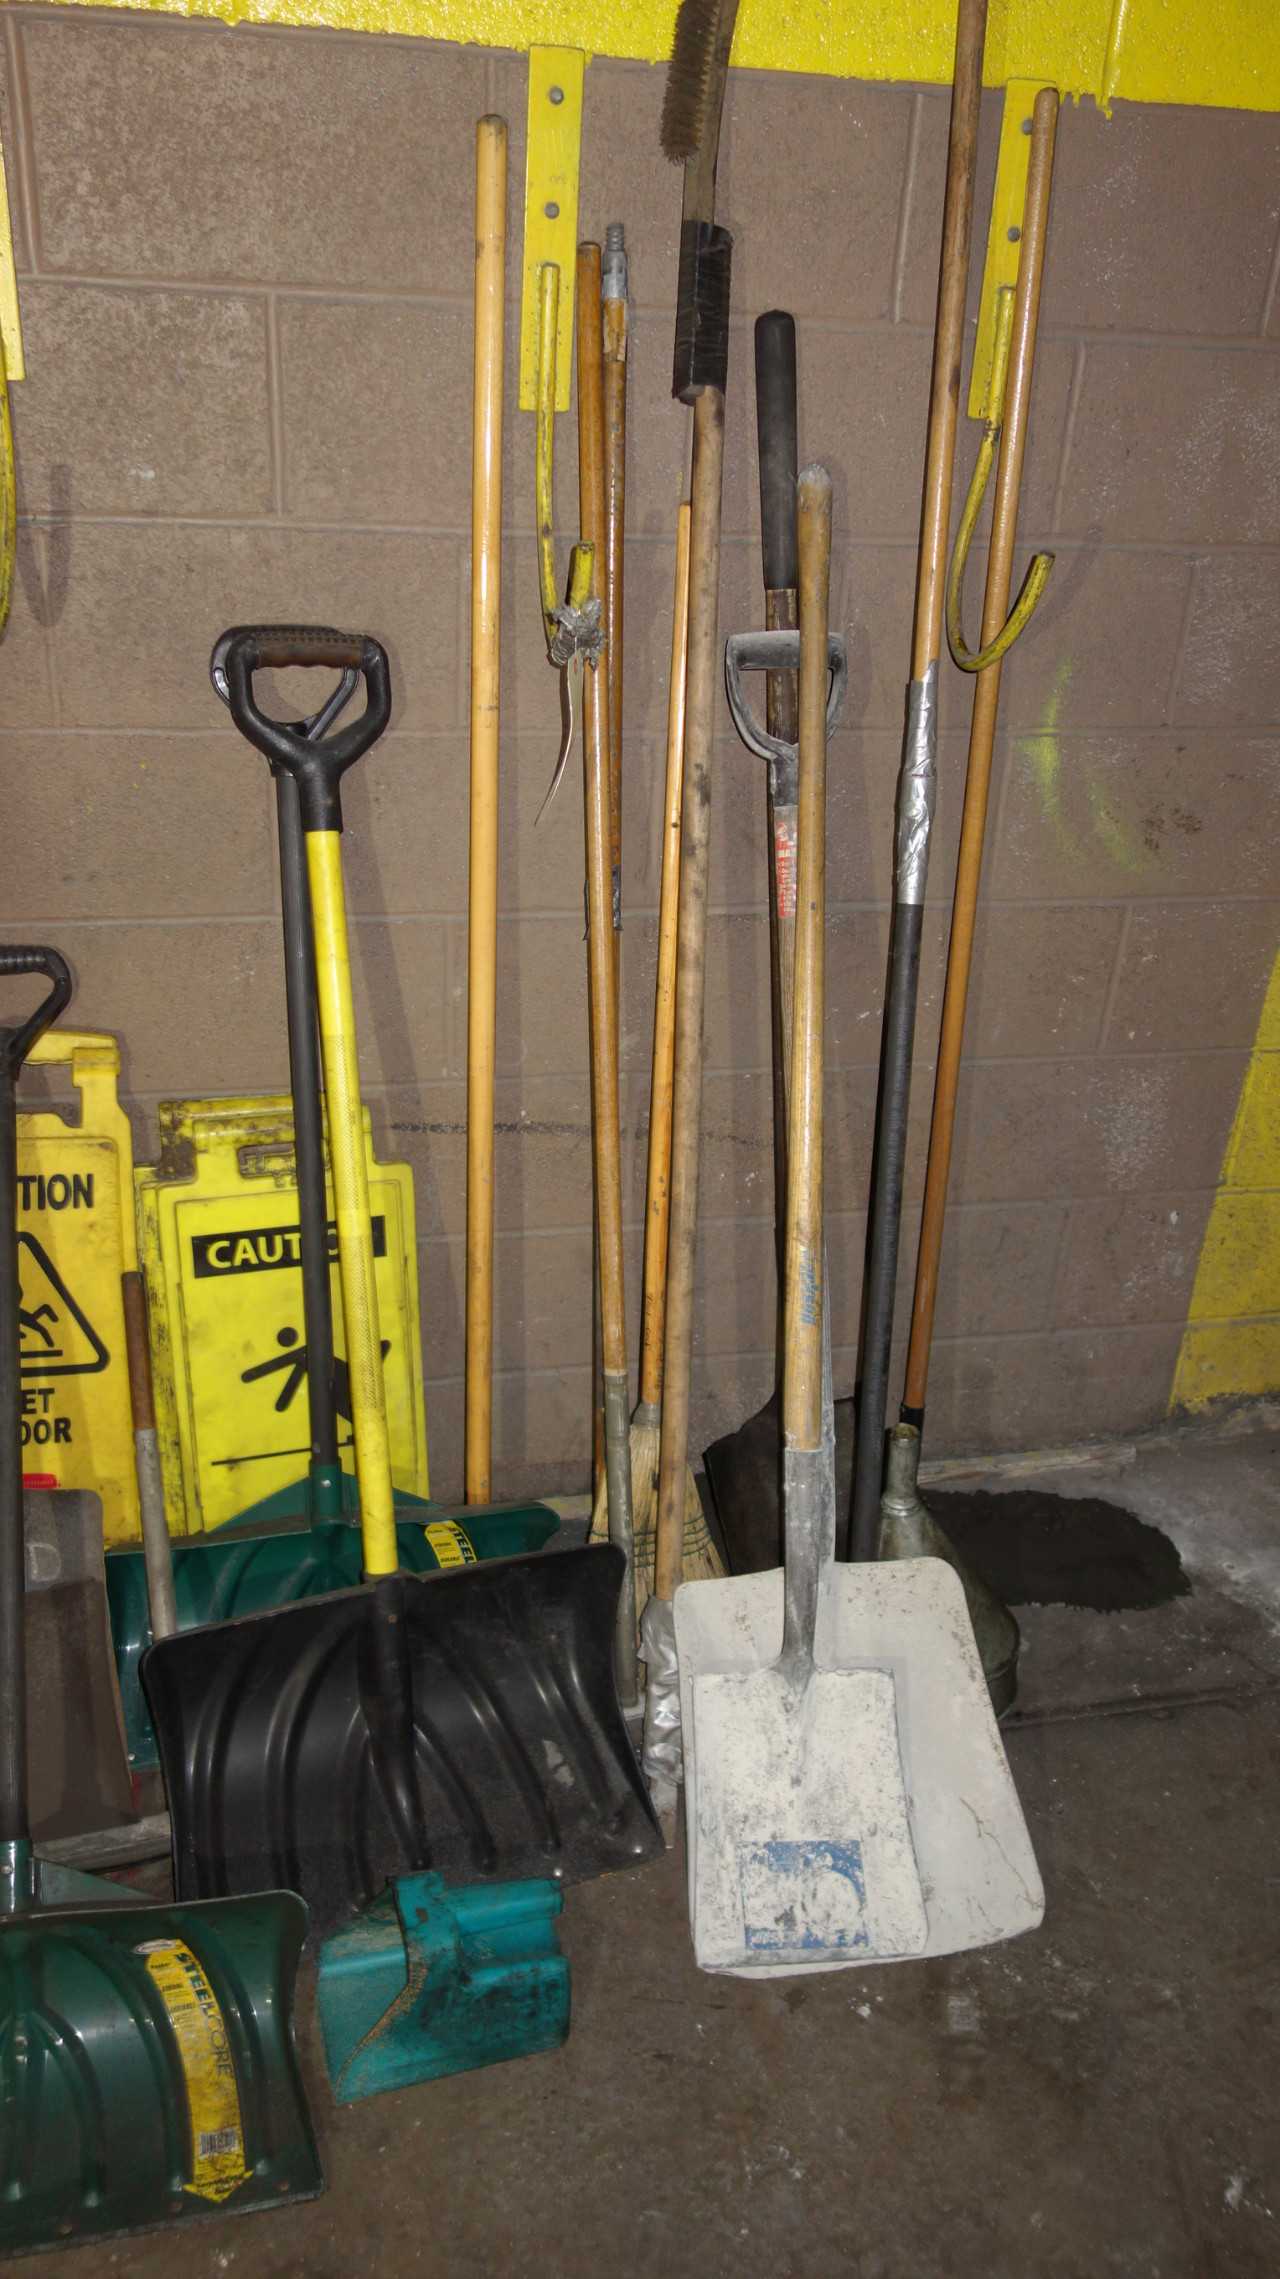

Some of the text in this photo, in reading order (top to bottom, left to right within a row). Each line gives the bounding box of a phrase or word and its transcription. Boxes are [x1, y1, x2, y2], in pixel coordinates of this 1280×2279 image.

[17, 1173, 94, 1211] TION
[206, 1228, 338, 1269] CAUT
[21, 1388, 55, 1414] ET
[20, 1417, 72, 1446] OOR
